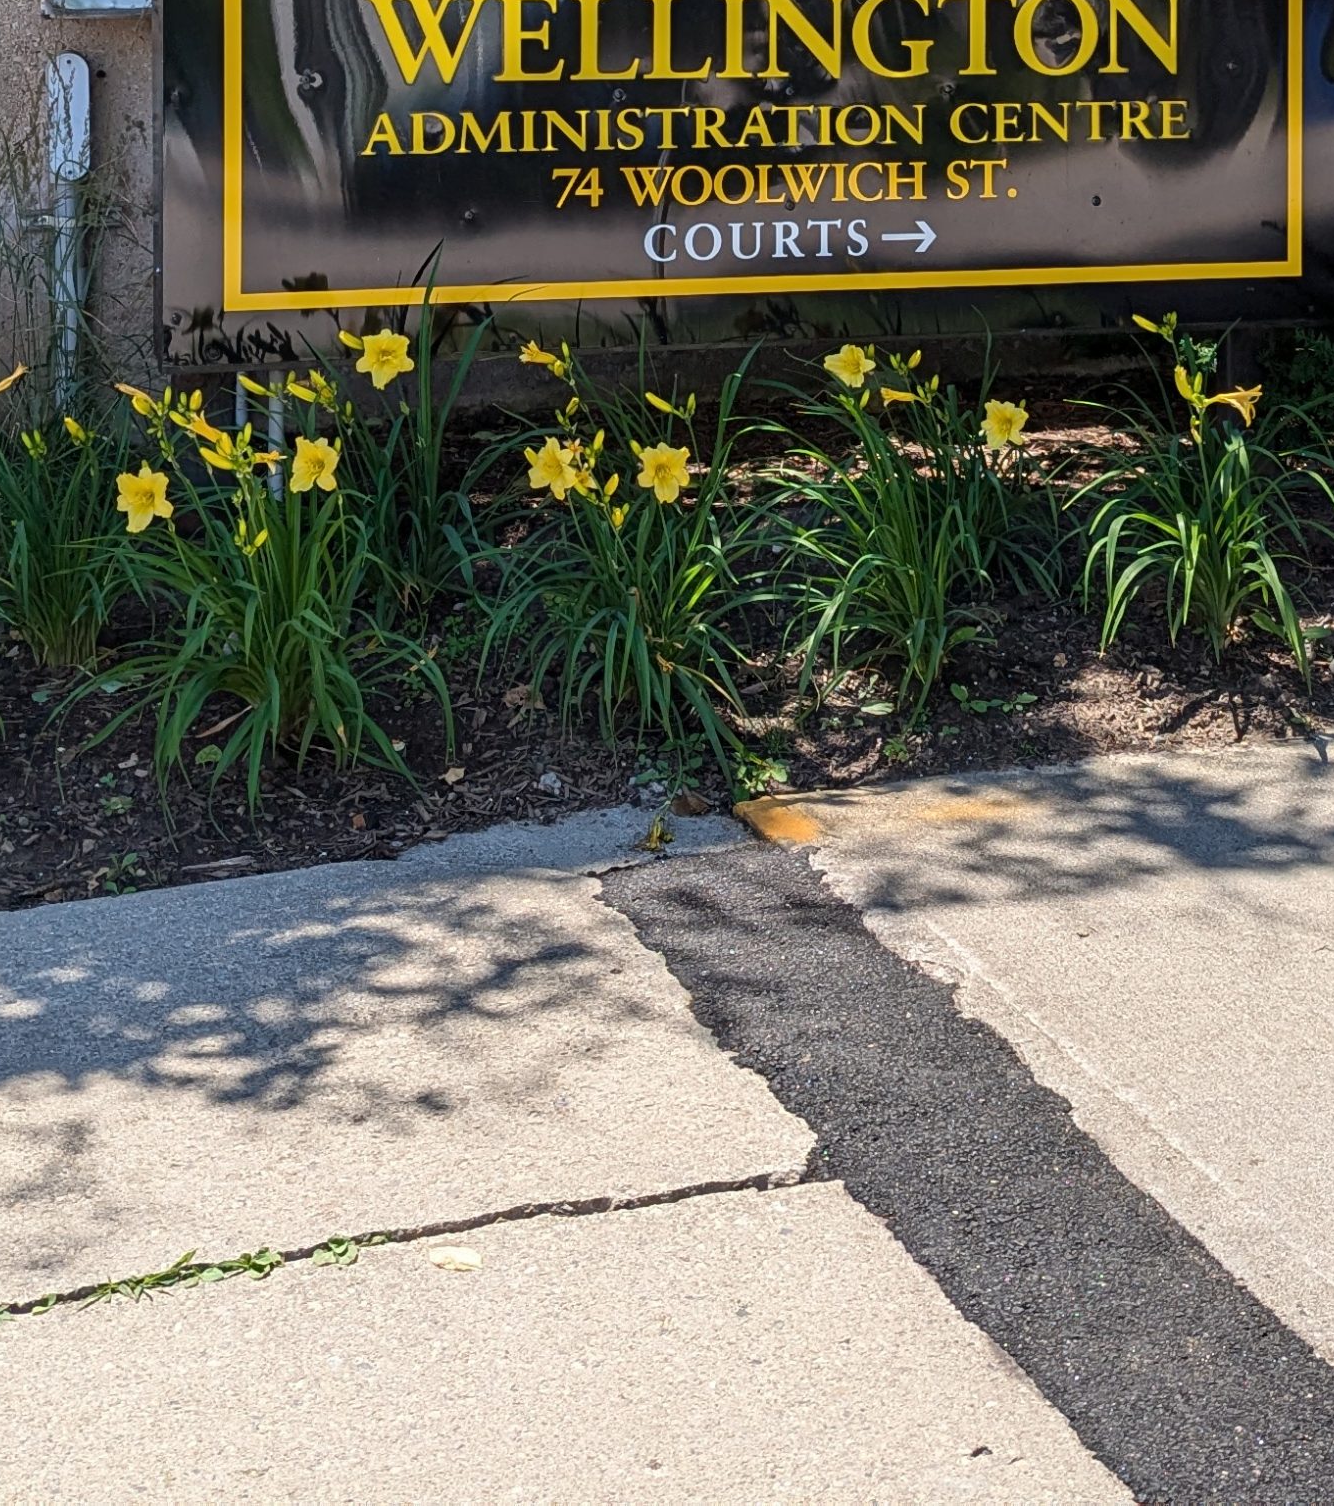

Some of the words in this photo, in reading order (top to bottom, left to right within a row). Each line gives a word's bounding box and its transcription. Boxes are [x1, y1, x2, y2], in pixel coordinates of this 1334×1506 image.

[361, 105, 925, 156] ADMINISTRATION
[948, 100, 1191, 144] CENTRE
[552, 167, 604, 209] 74
[619, 161, 927, 207] WOOLWICH
[945, 159, 1019, 200] ST.
[643, 218, 869, 262] COURTS
